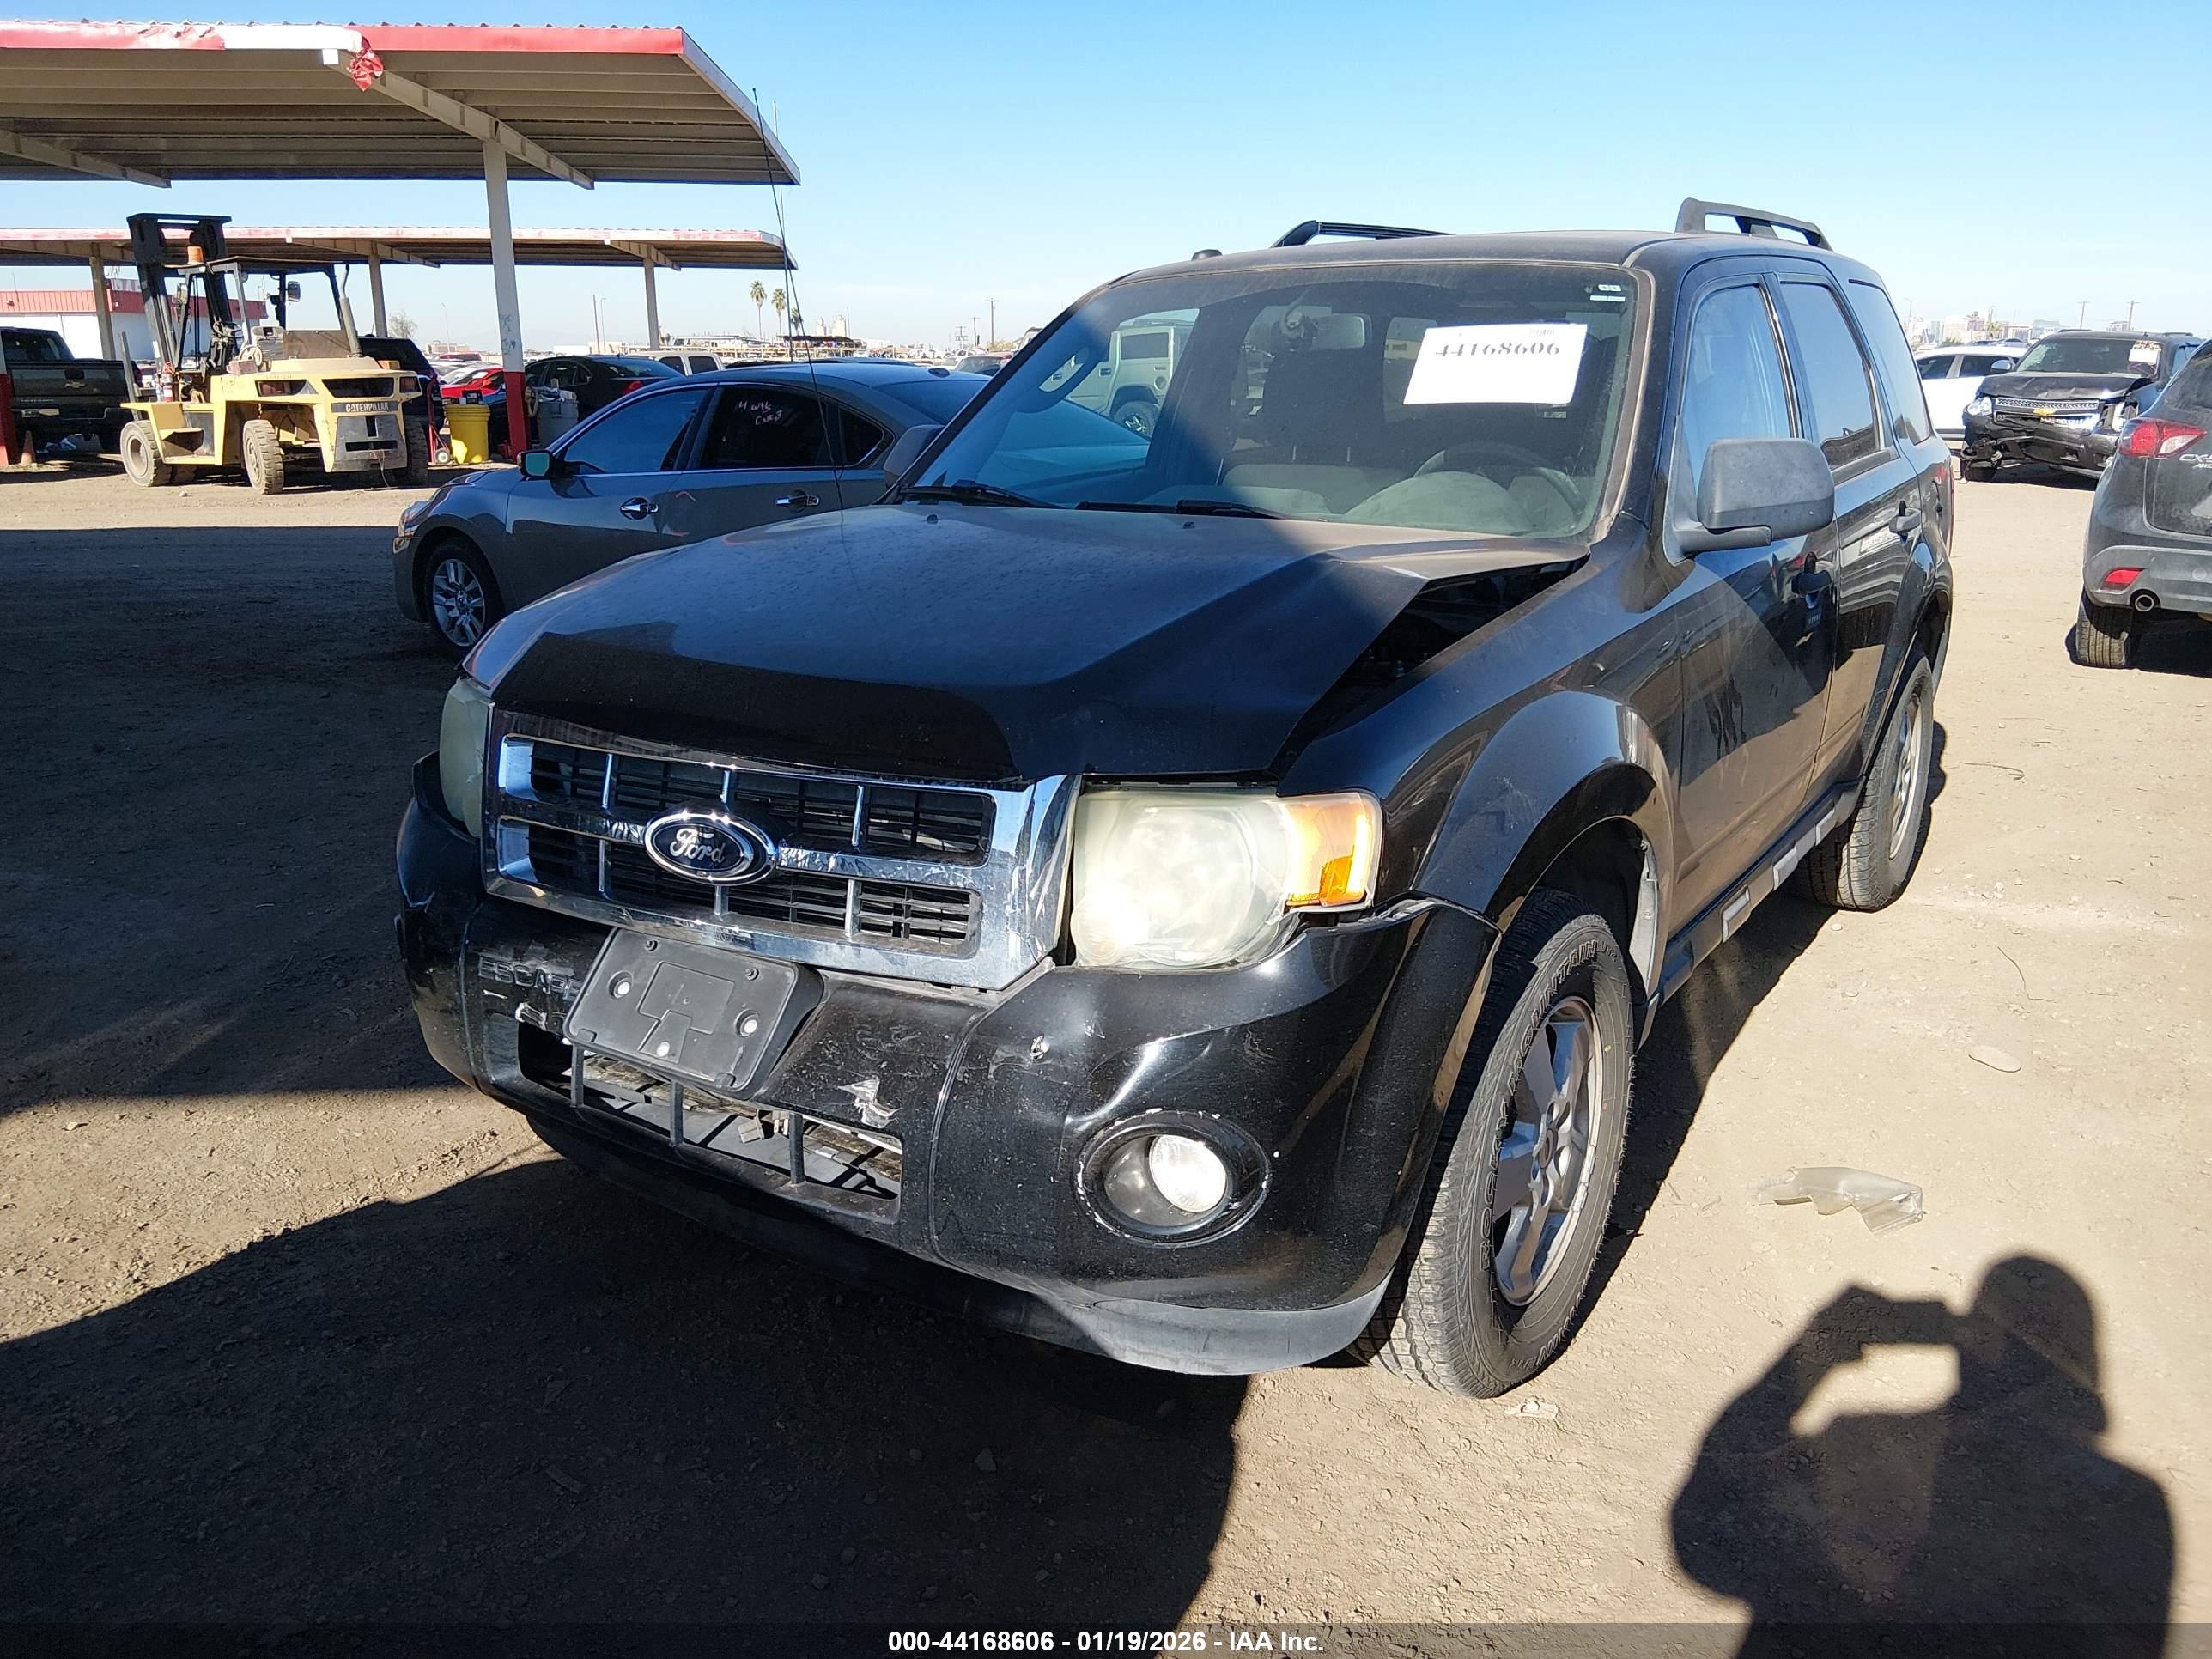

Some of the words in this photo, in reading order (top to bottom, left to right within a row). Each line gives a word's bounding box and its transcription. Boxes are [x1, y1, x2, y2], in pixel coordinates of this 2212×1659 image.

[1436, 343, 1560, 357] 44168606
[345, 402, 389, 413] CATERPILLAR
[669, 827, 726, 864] Ford
